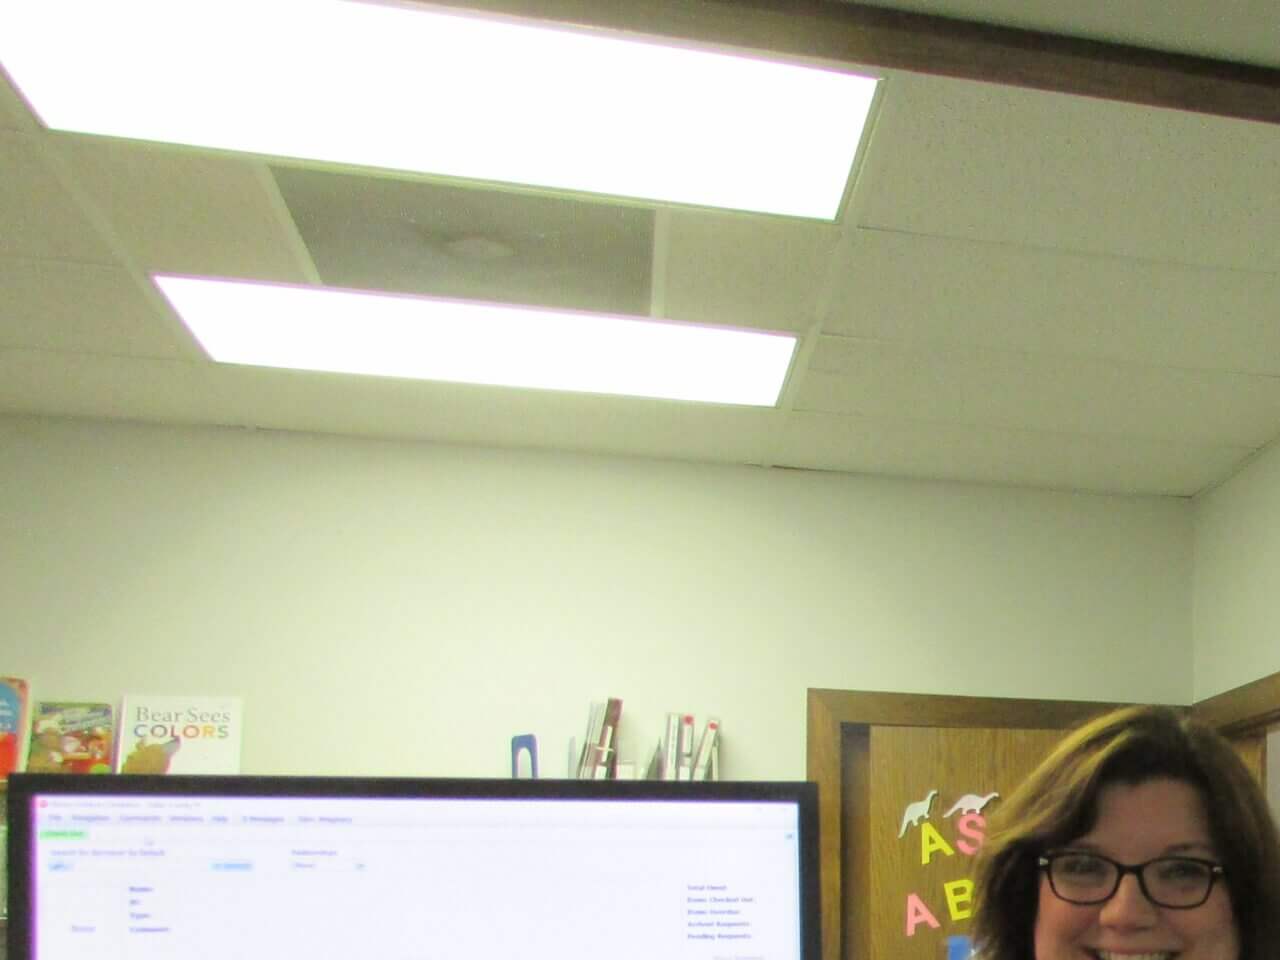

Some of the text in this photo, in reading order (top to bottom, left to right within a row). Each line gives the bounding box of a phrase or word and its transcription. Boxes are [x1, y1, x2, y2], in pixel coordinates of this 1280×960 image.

[135, 706, 231, 722] Bear Sees
[133, 724, 230, 739] COLORS
[921, 813, 987, 866] A S
[906, 893, 941, 938] A
